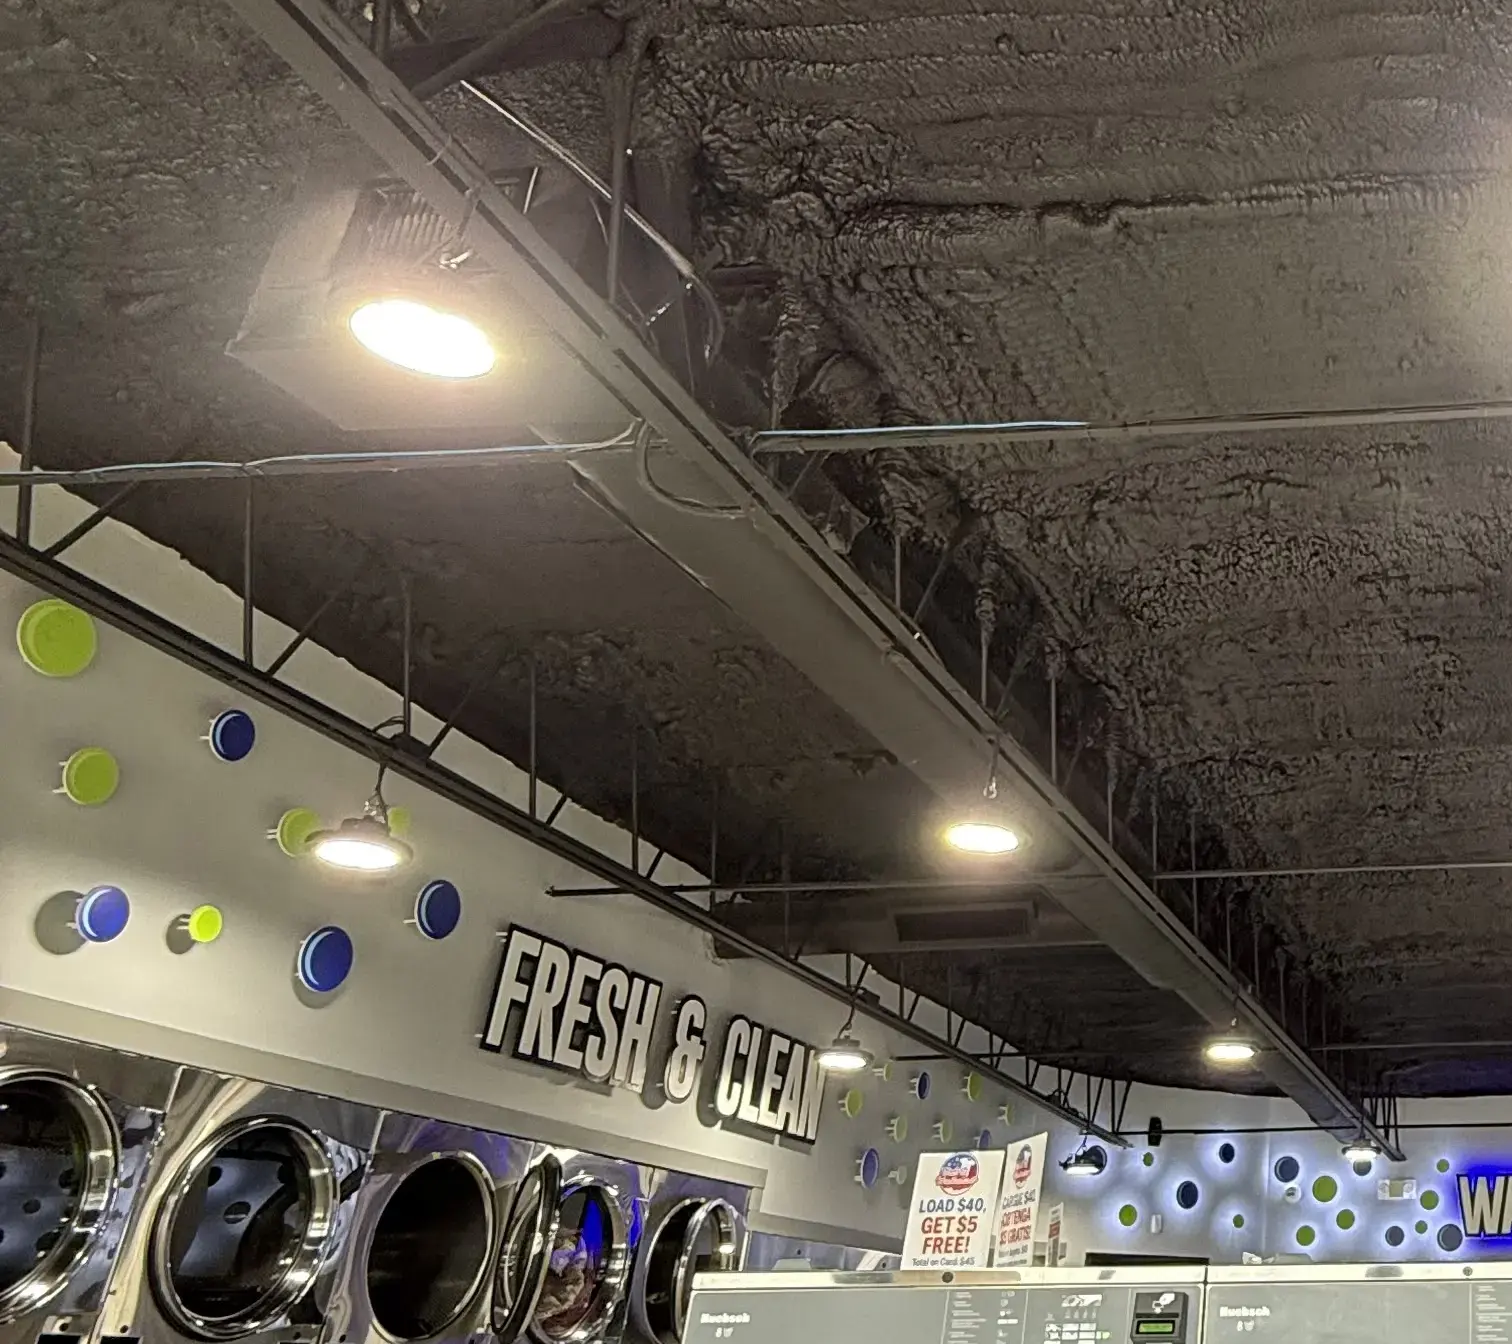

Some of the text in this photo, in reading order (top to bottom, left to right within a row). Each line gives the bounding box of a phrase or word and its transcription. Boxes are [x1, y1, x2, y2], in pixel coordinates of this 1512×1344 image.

[482, 926, 825, 1143] FRESH & CLEAN
[919, 1198, 986, 1214] LOAD $40,
[921, 1215, 978, 1235] GET $5
[922, 1237, 970, 1255] FREE!
